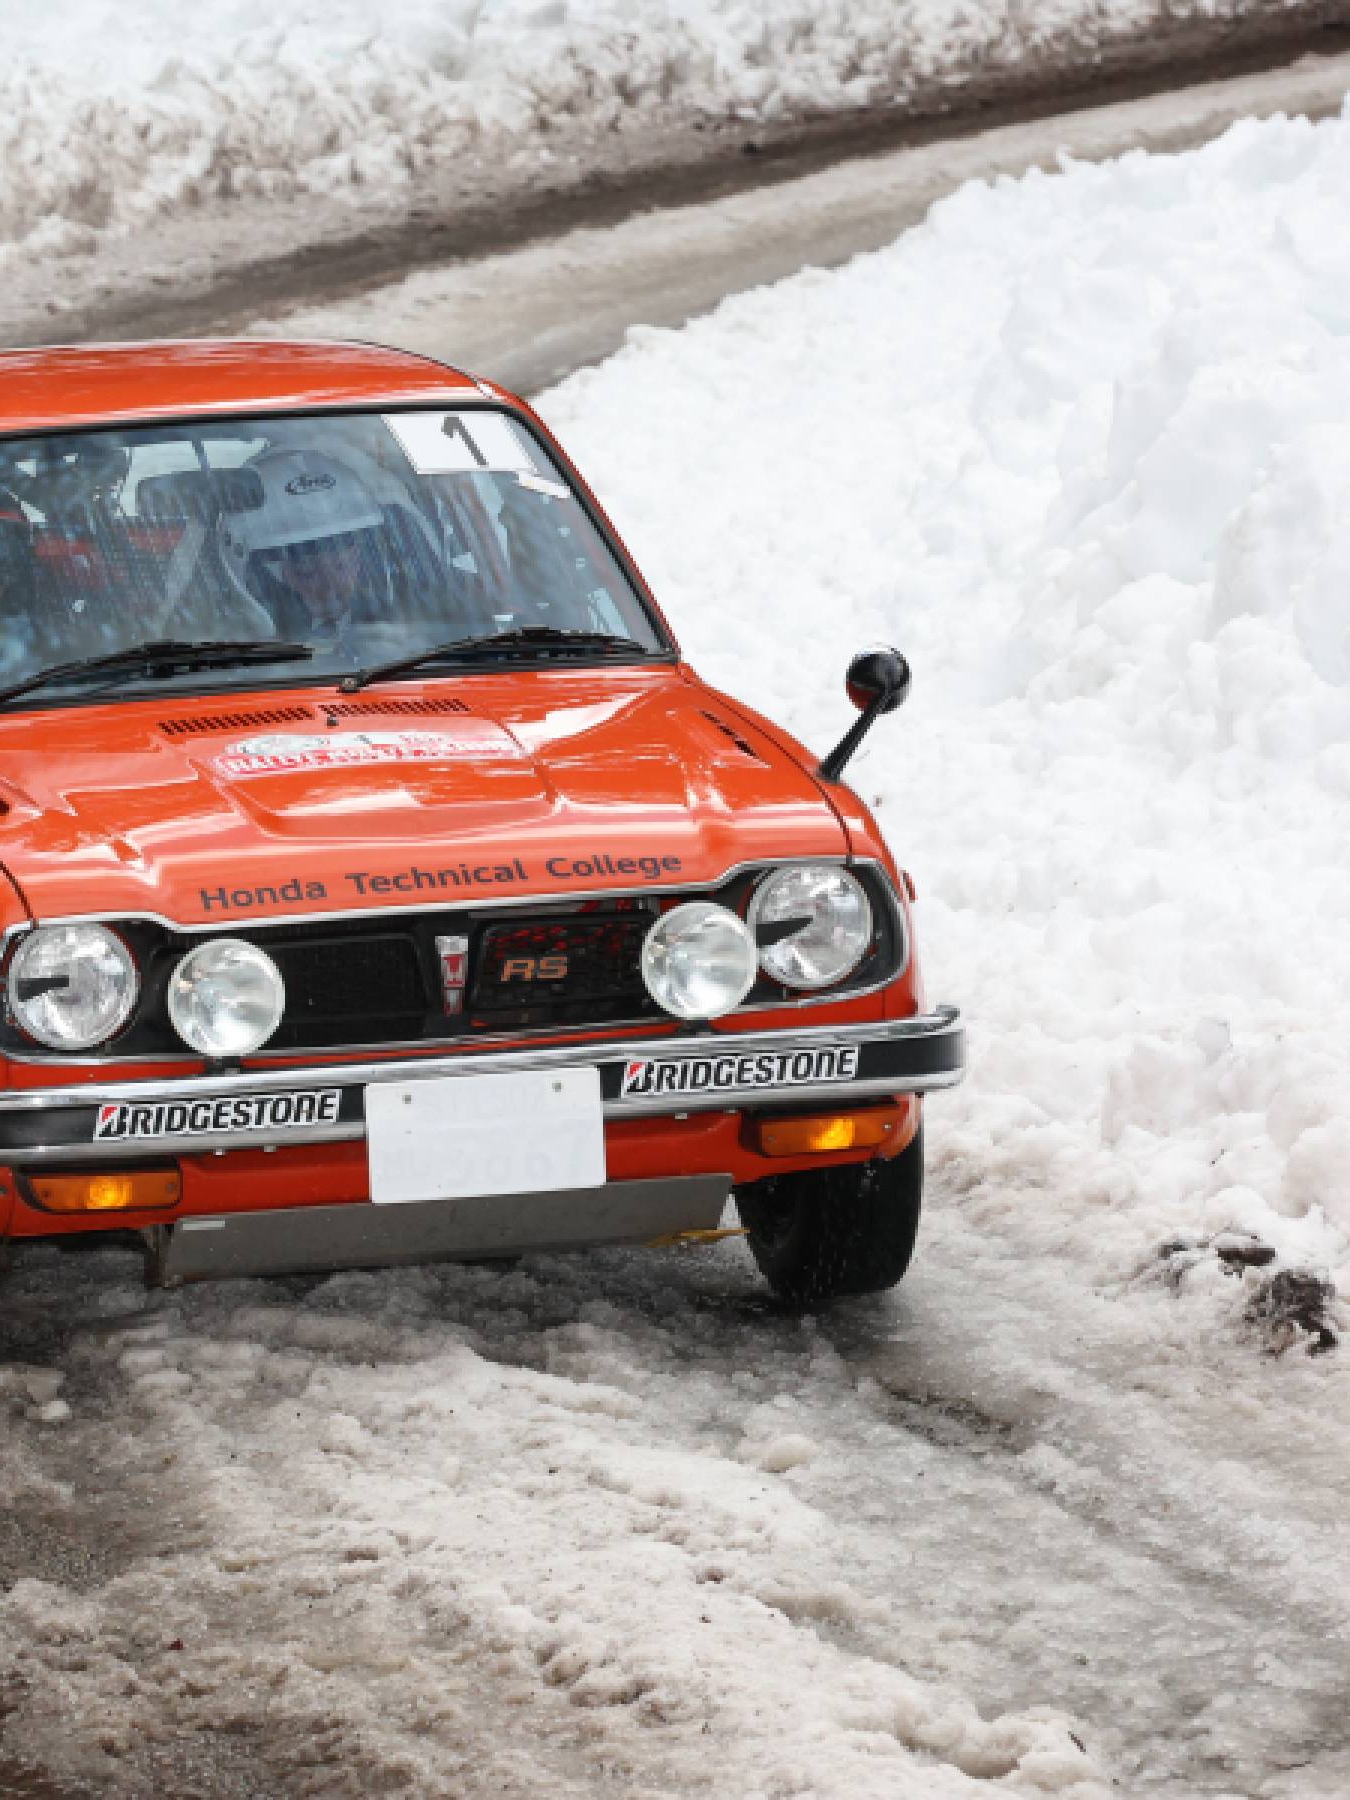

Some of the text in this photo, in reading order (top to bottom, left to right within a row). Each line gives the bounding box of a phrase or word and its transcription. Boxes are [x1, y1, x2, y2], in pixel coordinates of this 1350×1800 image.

[441, 416, 489, 466] 1
[199, 855, 681, 912] Honda Technical College
[501, 956, 568, 982] RS
[626, 1050, 857, 1093] BRIDGESTONE
[99, 1089, 337, 1138] BRIDGESTONE
